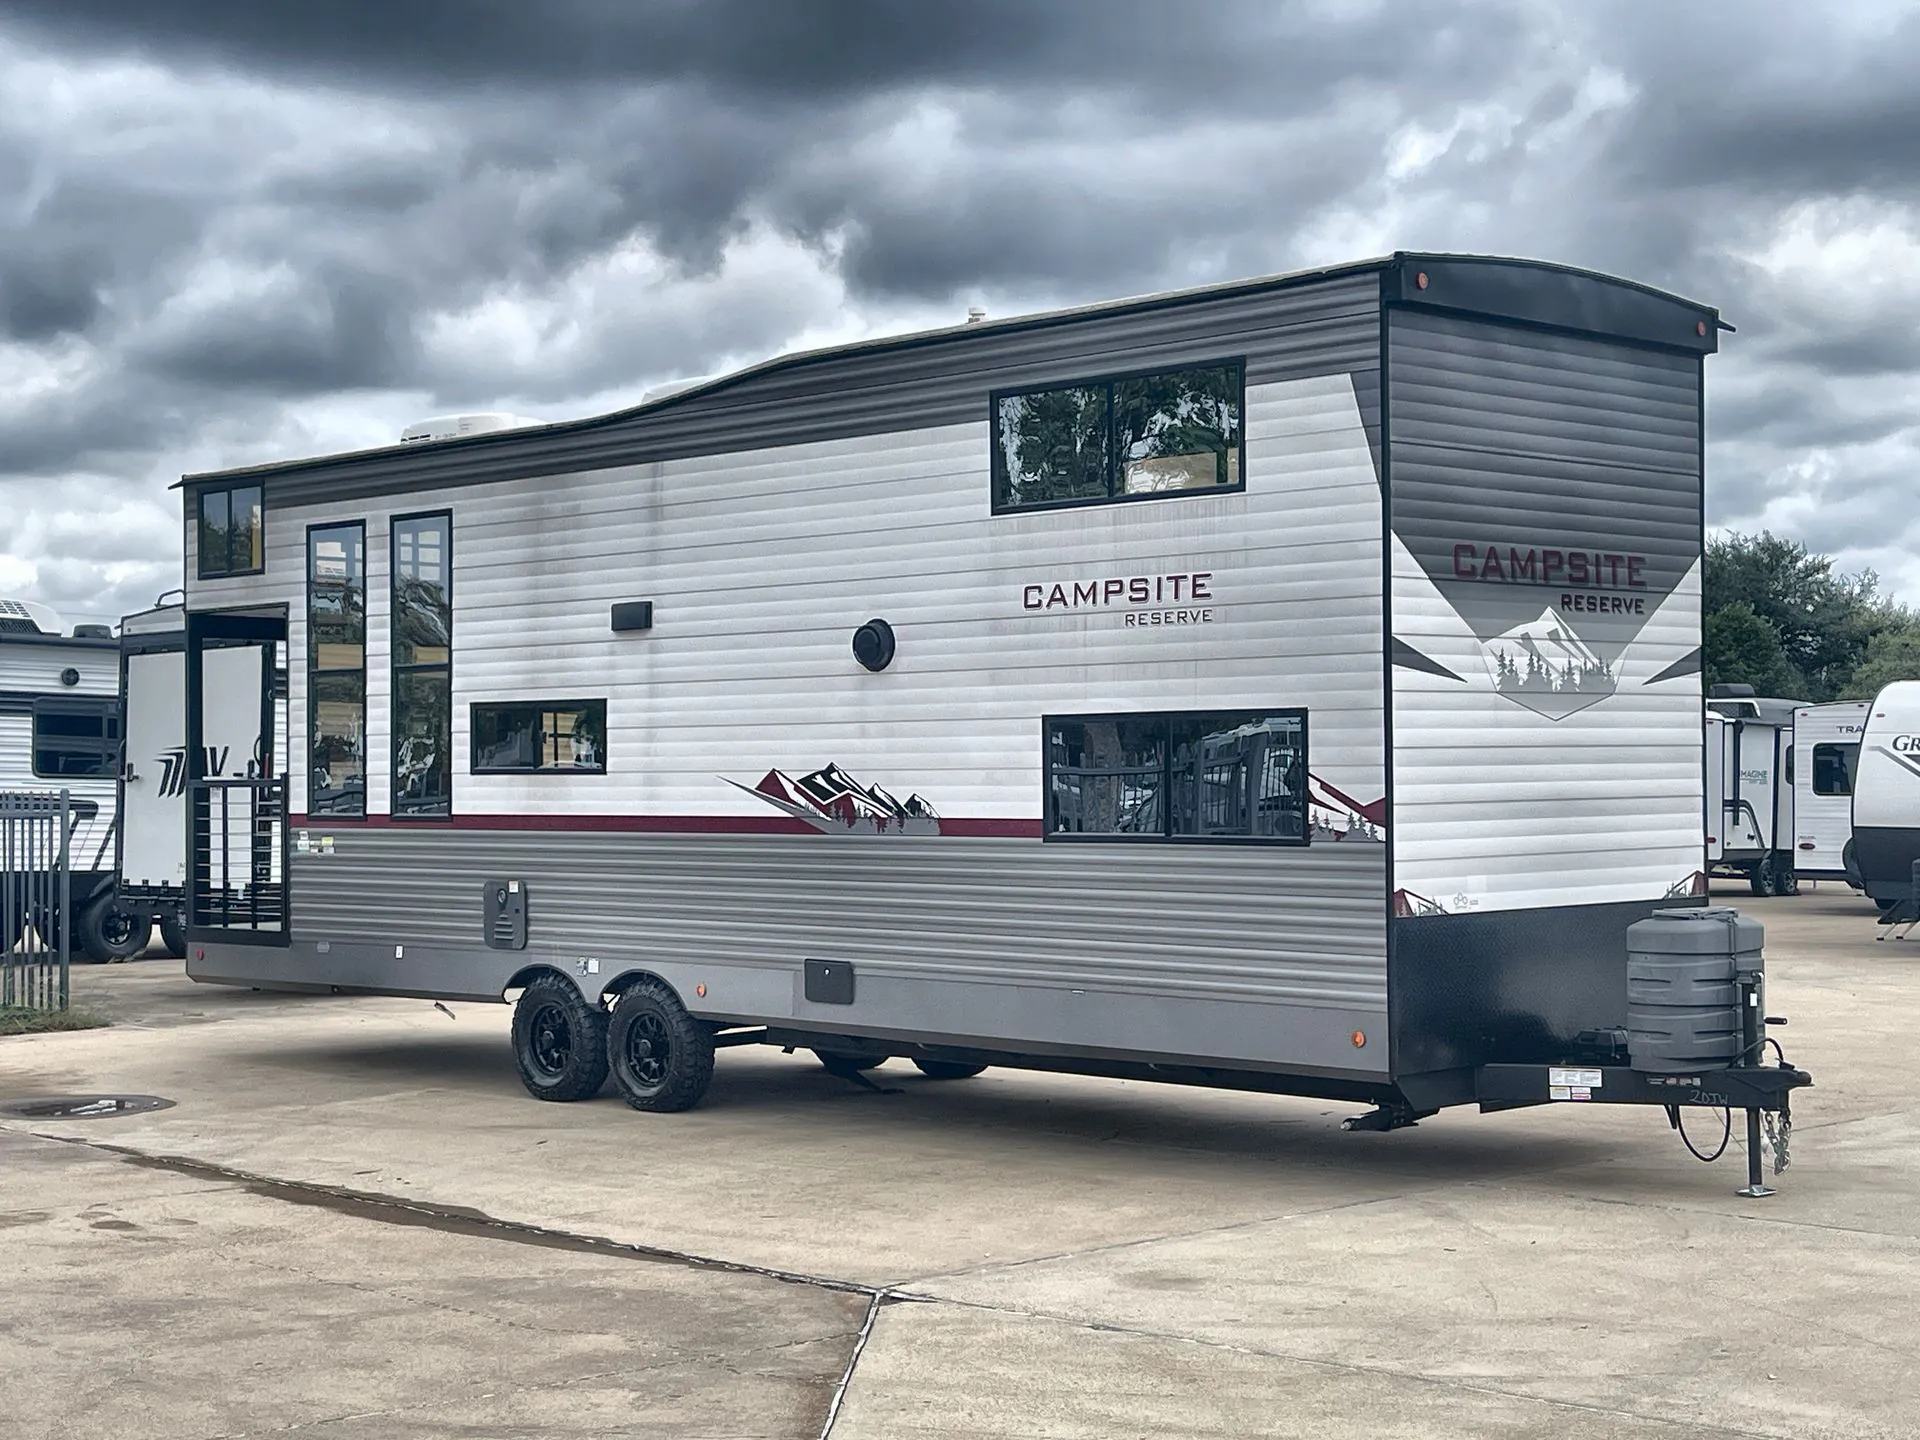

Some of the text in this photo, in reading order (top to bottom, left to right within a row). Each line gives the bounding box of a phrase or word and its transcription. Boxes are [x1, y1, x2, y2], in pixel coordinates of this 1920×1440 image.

[1452, 543, 1647, 589] CAMPSITE
[1023, 572, 1213, 611] CAMPSITE
[1560, 593, 1646, 615] RESERVE
[1124, 609, 1213, 628] RESERVE
